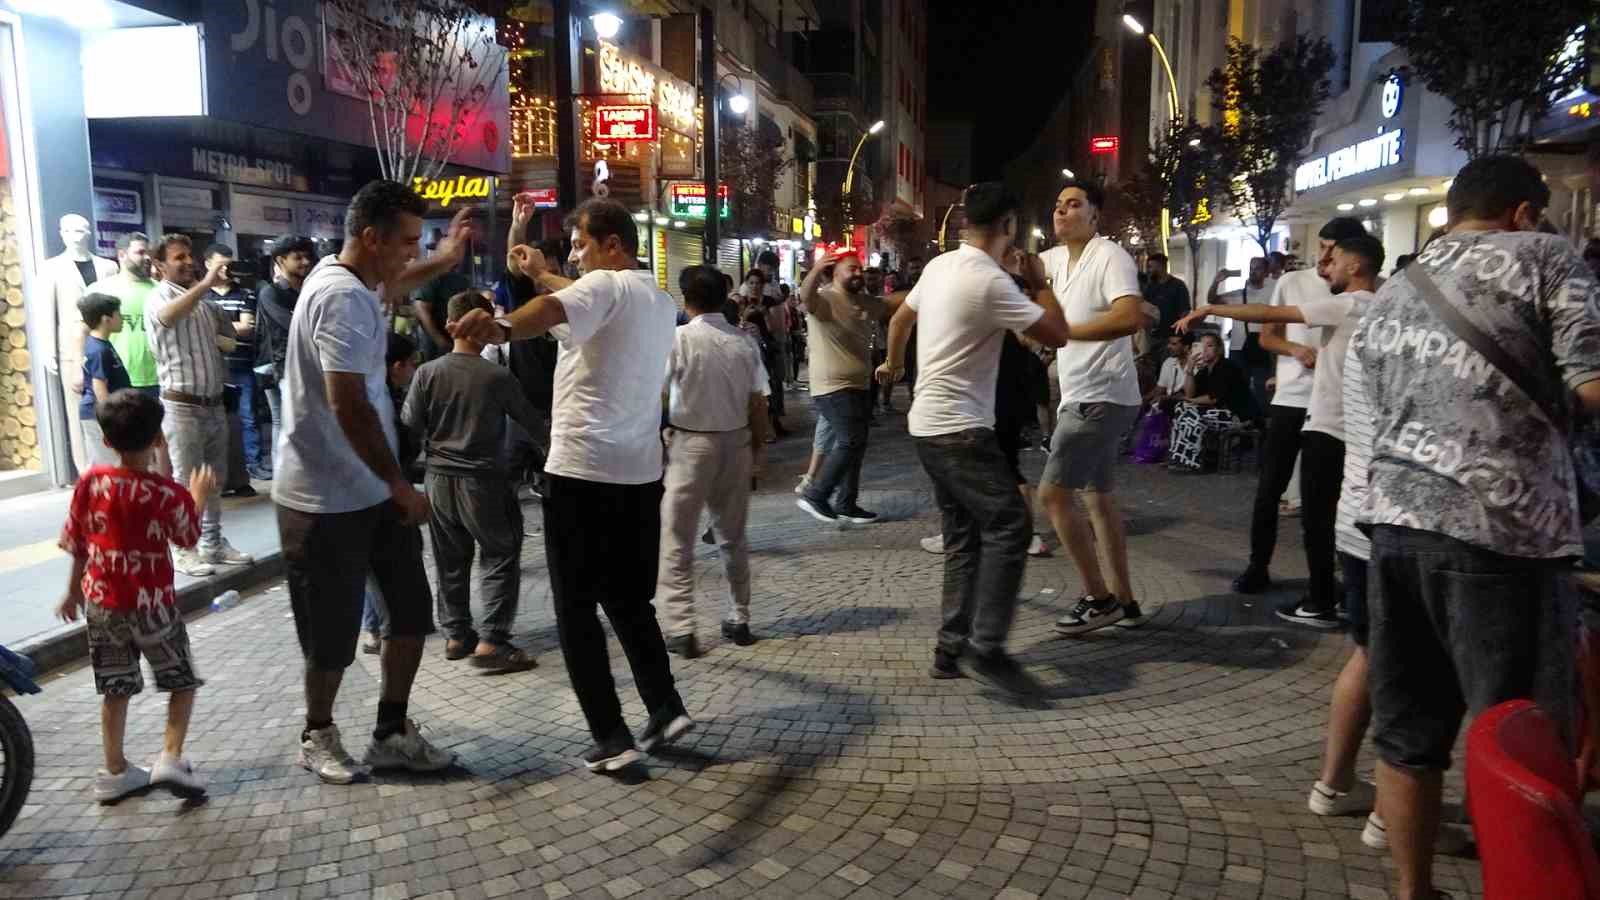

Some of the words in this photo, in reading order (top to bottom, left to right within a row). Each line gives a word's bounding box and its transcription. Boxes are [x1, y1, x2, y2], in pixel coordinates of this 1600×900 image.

[191, 145, 249, 178] METRO
[255, 158, 295, 185] SPOT
[89, 474, 176, 511] ARTIST
